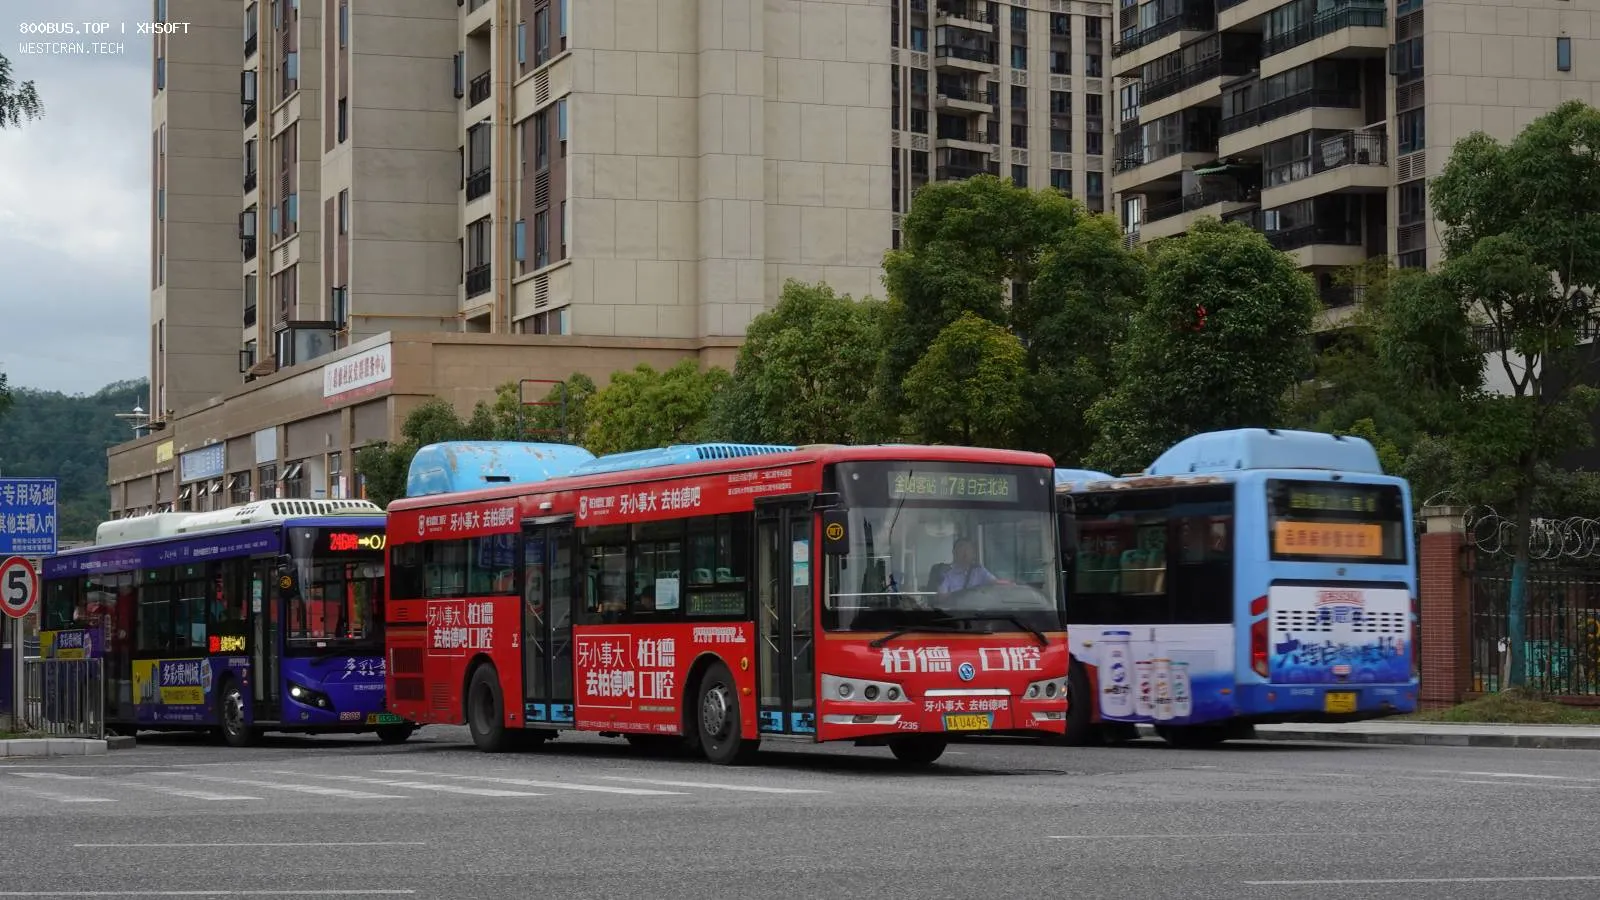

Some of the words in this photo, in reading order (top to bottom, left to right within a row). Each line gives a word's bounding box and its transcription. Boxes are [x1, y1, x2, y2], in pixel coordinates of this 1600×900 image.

[0, 483, 54, 506] 专用场地
[967, 478, 1009, 496] 白云北站
[619, 491, 657, 514] 牙小事大
[660, 486, 701, 510] 去柏德吧
[450, 510, 480, 531] 牙小事大
[483, 506, 514, 528] 去柏德吧
[8, 570, 28, 605] 5
[428, 605, 461, 627] 牙小事大
[468, 602, 494, 625] 柏德
[433, 627, 468, 649] 去柏德吧
[468, 627, 493, 649] 口腔
[578, 641, 625, 668] 牙小事大
[637, 638, 675, 667] 柏德
[879, 646, 952, 673] 柏德
[978, 646, 1043, 672] 口腔
[163, 662, 199, 686] 多彩贵州城
[586, 669, 635, 697] 去柏德吧
[638, 670, 675, 699] 口腔
[924, 700, 965, 712] 牙小事大
[968, 699, 1009, 711] 去柏德吧
[897, 720, 918, 730] 7235
